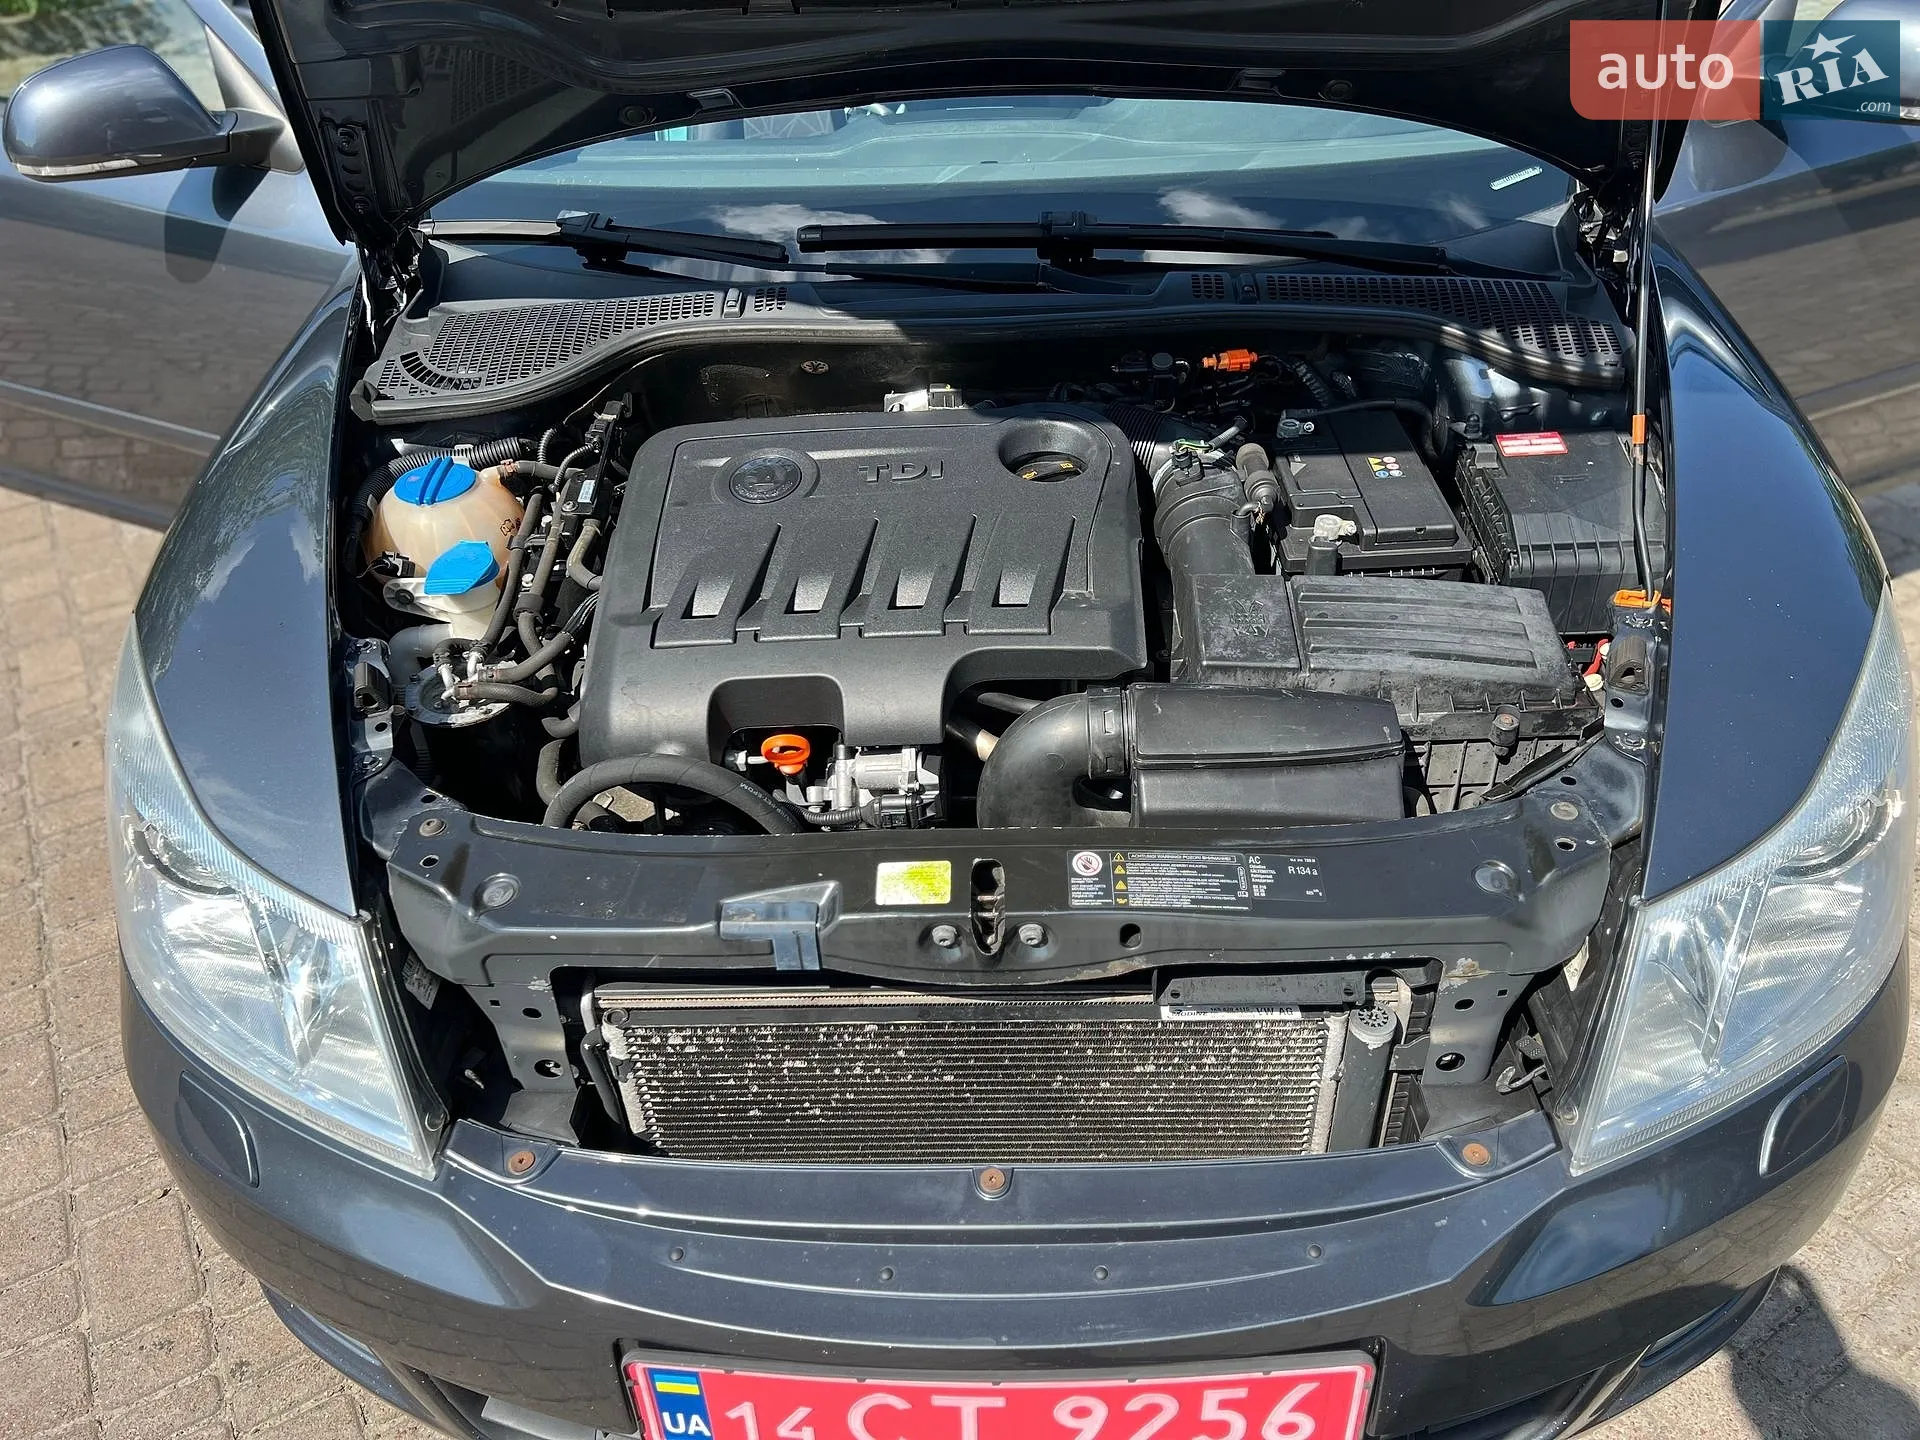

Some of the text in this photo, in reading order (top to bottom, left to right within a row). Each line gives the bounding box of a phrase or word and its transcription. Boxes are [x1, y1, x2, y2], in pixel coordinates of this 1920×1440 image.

[858, 459, 945, 484] TDI
[1248, 855, 1261, 864] AC
[1256, 1007, 1294, 1016] VW AG
[725, 1382, 1321, 1440] 14 CT 9256
[661, 1411, 712, 1437] UA
